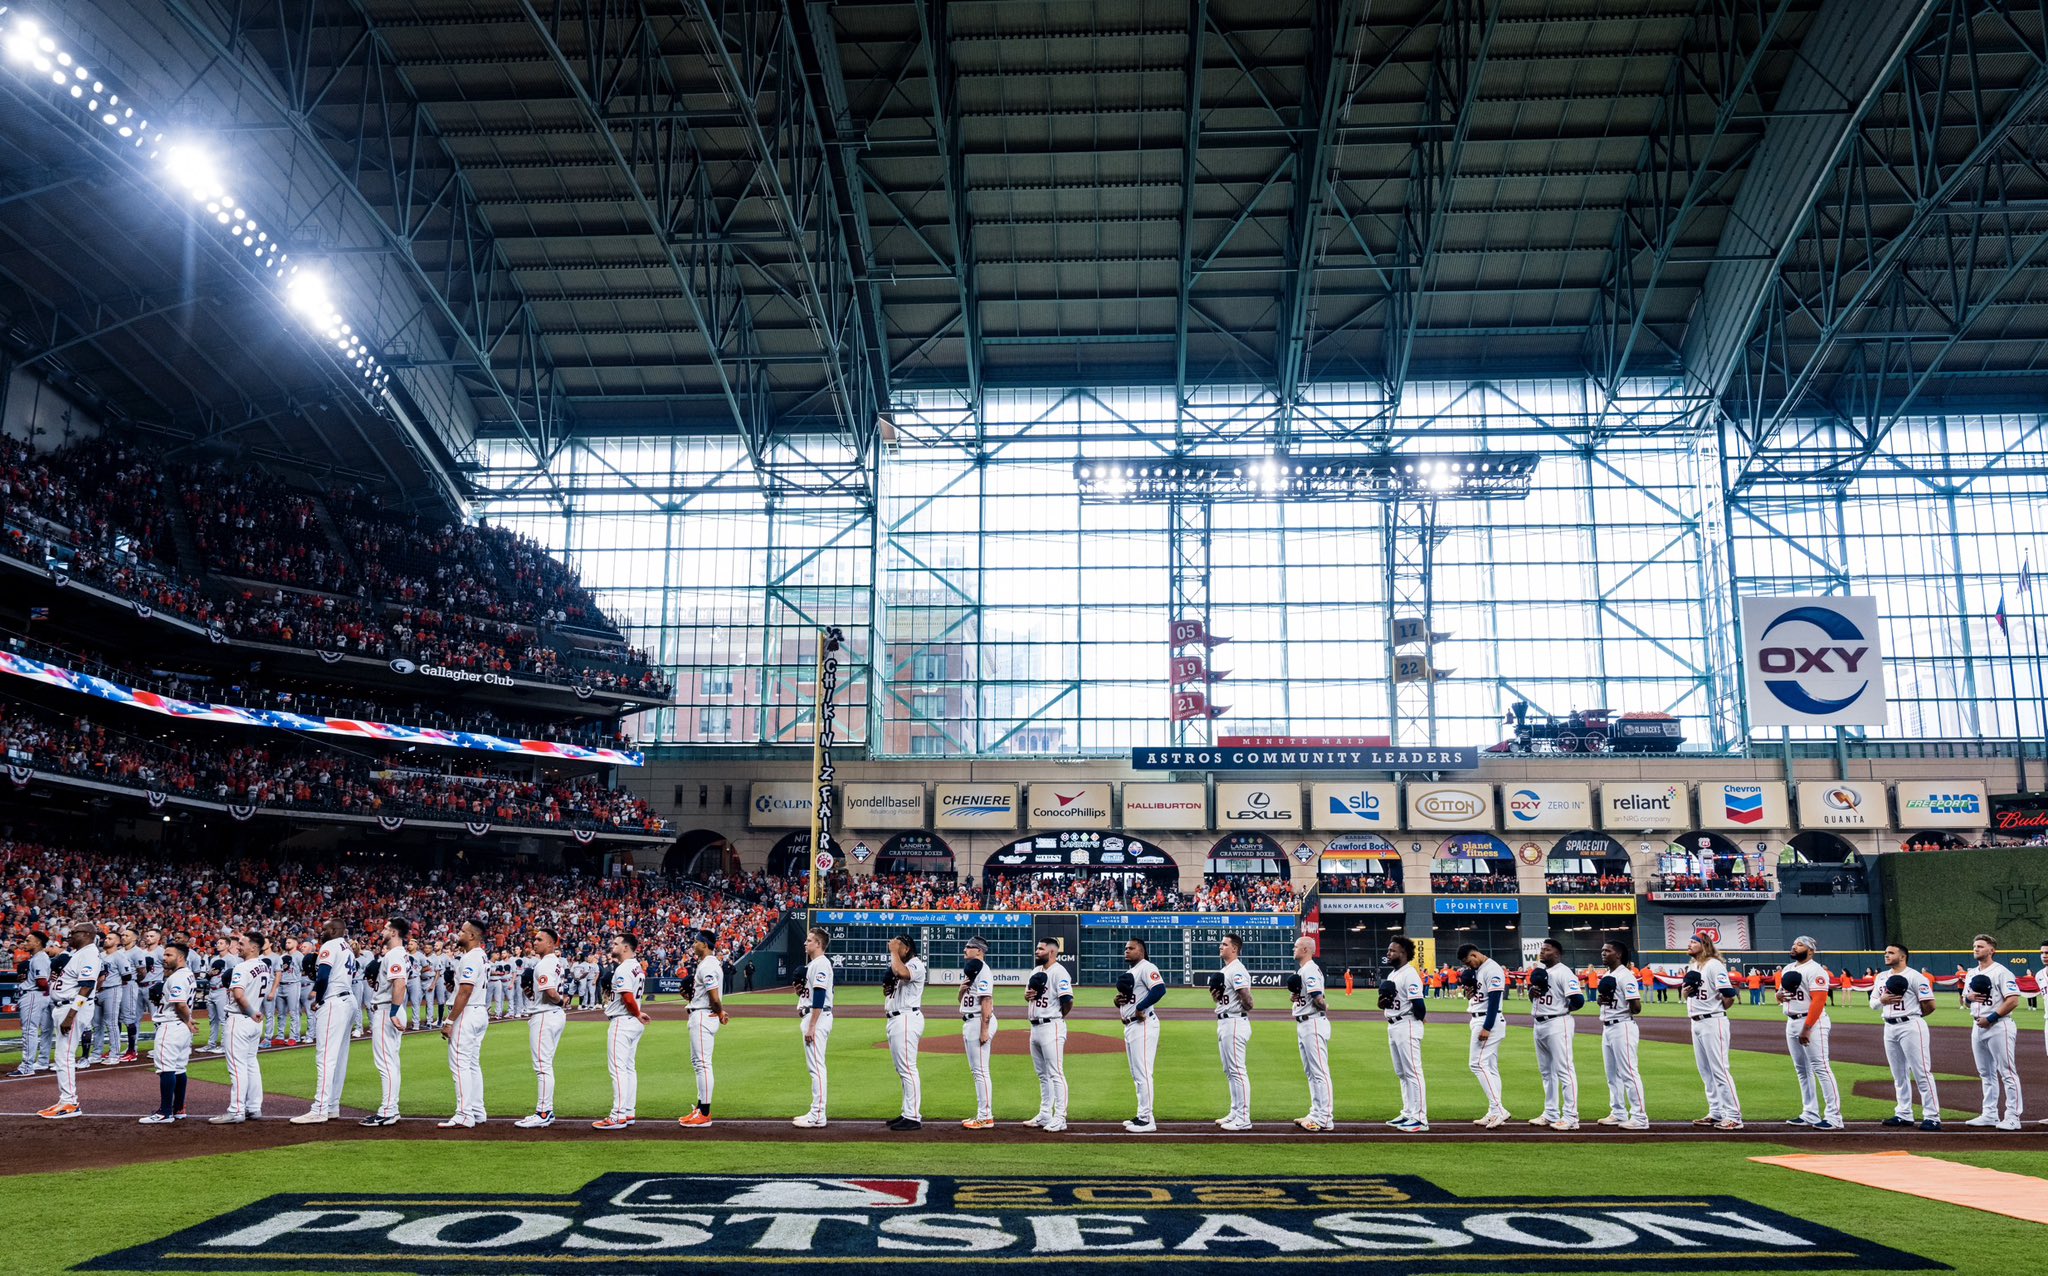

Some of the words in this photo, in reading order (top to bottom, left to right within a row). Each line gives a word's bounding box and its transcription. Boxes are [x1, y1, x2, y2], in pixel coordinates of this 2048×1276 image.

[1177, 625, 1195, 640] 05
[1400, 623, 1418, 638] 17
[1759, 647, 1869, 674] OXY
[1179, 662, 1197, 677] 19
[1400, 662, 1419, 676] 22
[419, 664, 482, 682] Gallagher
[483, 672, 514, 686] Club
[1178, 697, 1195, 711] 21
[1146, 752, 1223, 764] ASTROS
[1232, 752, 1362, 764] COMMUNITY
[1371, 752, 1464, 764] LEADERS
[1724, 785, 1762, 794] Chevron
[774, 799, 812, 809] CALPIN
[847, 795, 921, 810] lyondellbasell
[943, 795, 1011, 806] CHENIERE
[1349, 791, 1380, 809] slb
[1613, 795, 1671, 810] reliant
[1907, 800, 1970, 808] FREEPORT
[1929, 794, 1981, 814] LNG
[1425, 798, 1475, 815] COTTON
[1511, 802, 1541, 810] OXY
[1547, 802, 1571, 810] ZERO
[1033, 808, 1106, 819] ConocoPhillips
[1227, 811, 1293, 820] LEXUS
[1824, 815, 1865, 823] QUANTA
[1641, 817, 1672, 825] company
[1996, 811, 2048, 828] Bud
[1330, 842, 1367, 850] Crawford
[1369, 842, 1390, 850] Bock
[1462, 842, 1493, 852] planet
[1565, 840, 1591, 851] SPACE
[1591, 840, 1609, 851] CITY
[1466, 848, 1499, 857] fitness
[1578, 902, 1599, 911] PAPA
[1601, 902, 1631, 911] JOHN'S
[791, 912, 807, 920] 315
[901, 914, 929, 923] Through
[1183, 931, 1191, 983] AMERICAN
[963, 996, 974, 1007] 68
[1036, 997, 1048, 1008] 65
[953, 1185, 1412, 1204] 2023
[196, 1210, 1816, 1251] POSTSEASON
